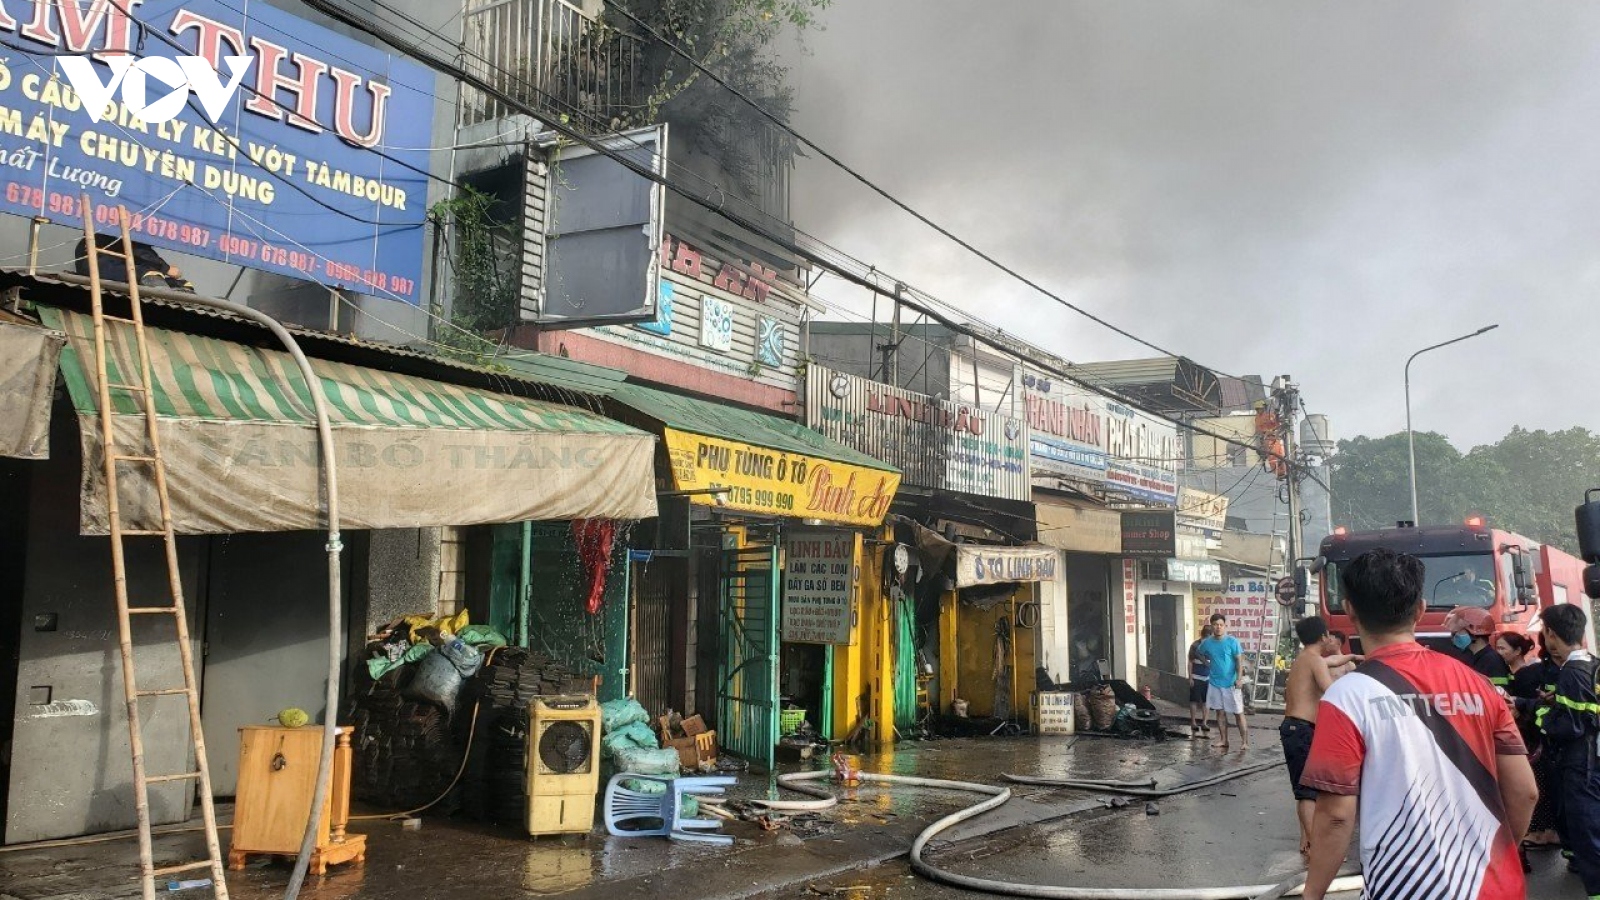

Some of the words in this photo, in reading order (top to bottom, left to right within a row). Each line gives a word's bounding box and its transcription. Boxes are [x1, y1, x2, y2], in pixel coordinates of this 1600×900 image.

[0, 0, 142, 63] M
[48, 156, 124, 198] Lượng
[79, 129, 196, 184] CHUYÊN
[203, 163, 276, 206] DỤNG
[193, 126, 241, 161] KẾT
[248, 143, 297, 178] VỚT
[305, 160, 407, 211] TÂMBOUR
[6, 181, 45, 209] 678
[146, 215, 178, 241] 678
[260, 243, 288, 267] 678
[390, 278, 415, 296] 987
[696, 441, 731, 478] PHỤ
[733, 444, 773, 481] TÙNG
[776, 452, 787, 481] Ô
[790, 456, 808, 485] TÔ
[754, 489, 774, 509] 999
[775, 492, 794, 511] 990
[789, 540, 821, 559] LINH
[810, 559, 827, 576] CÁC
[804, 579, 815, 592] GA
[830, 579, 846, 592] BEN
